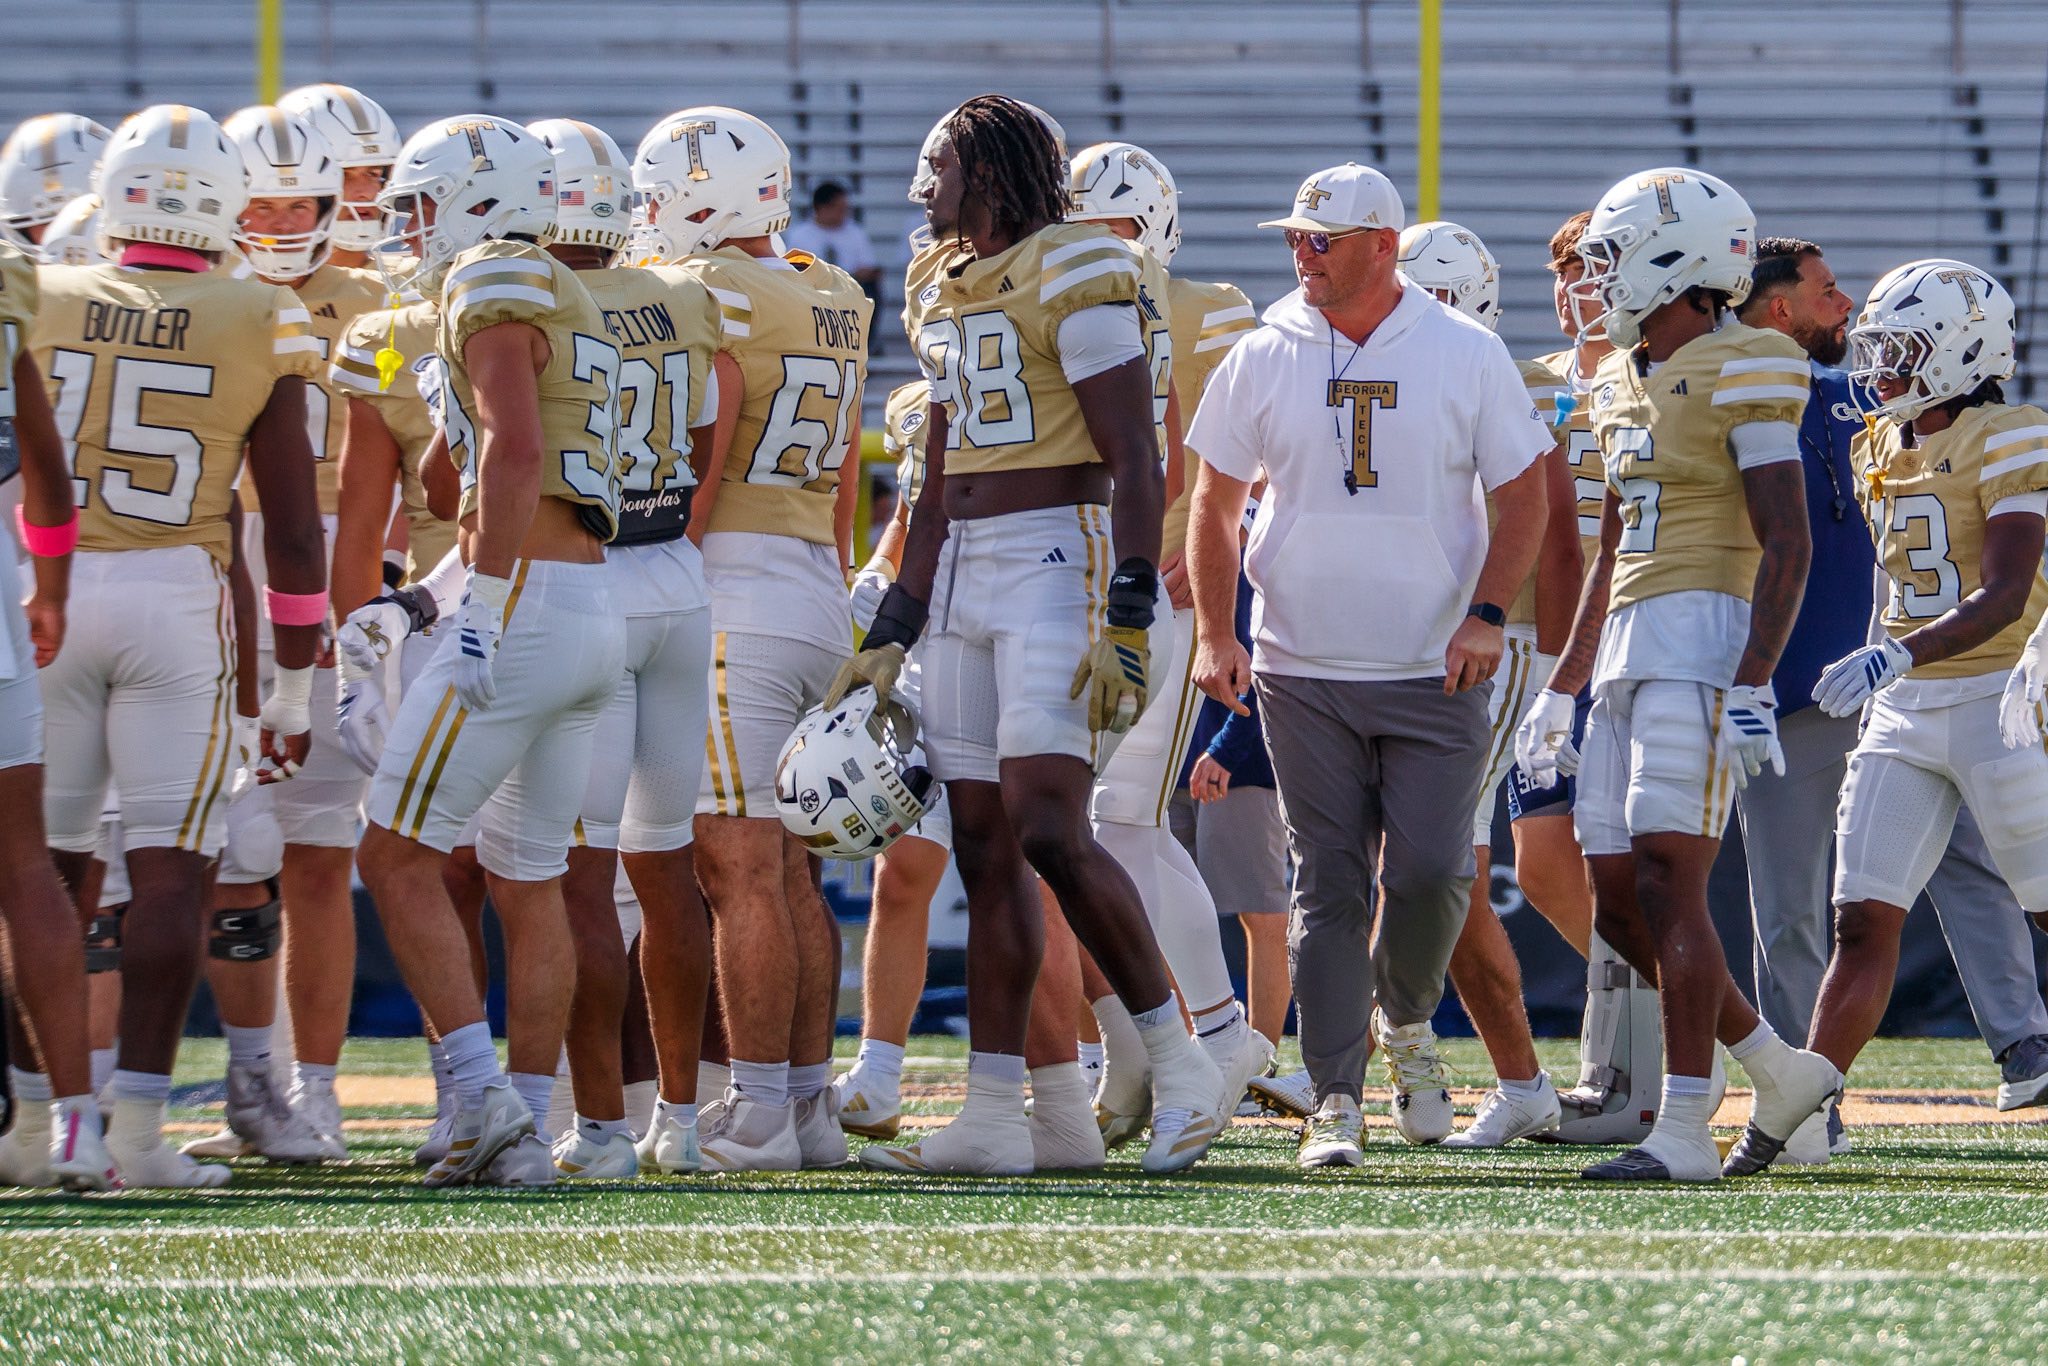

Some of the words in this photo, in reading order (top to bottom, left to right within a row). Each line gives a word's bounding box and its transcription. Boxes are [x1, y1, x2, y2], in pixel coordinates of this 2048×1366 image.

[130, 224, 209, 249] JACKETS
[84, 300, 191, 351] BUTLER
[602, 303, 677, 348] ELTON
[811, 306, 861, 351] PURVES
[919, 309, 1036, 451] 98
[1334, 384, 1390, 395] GEORGIA
[50, 347, 214, 526] 15
[1357, 405, 1367, 460] TECH
[874, 760, 922, 819] JACKETS
